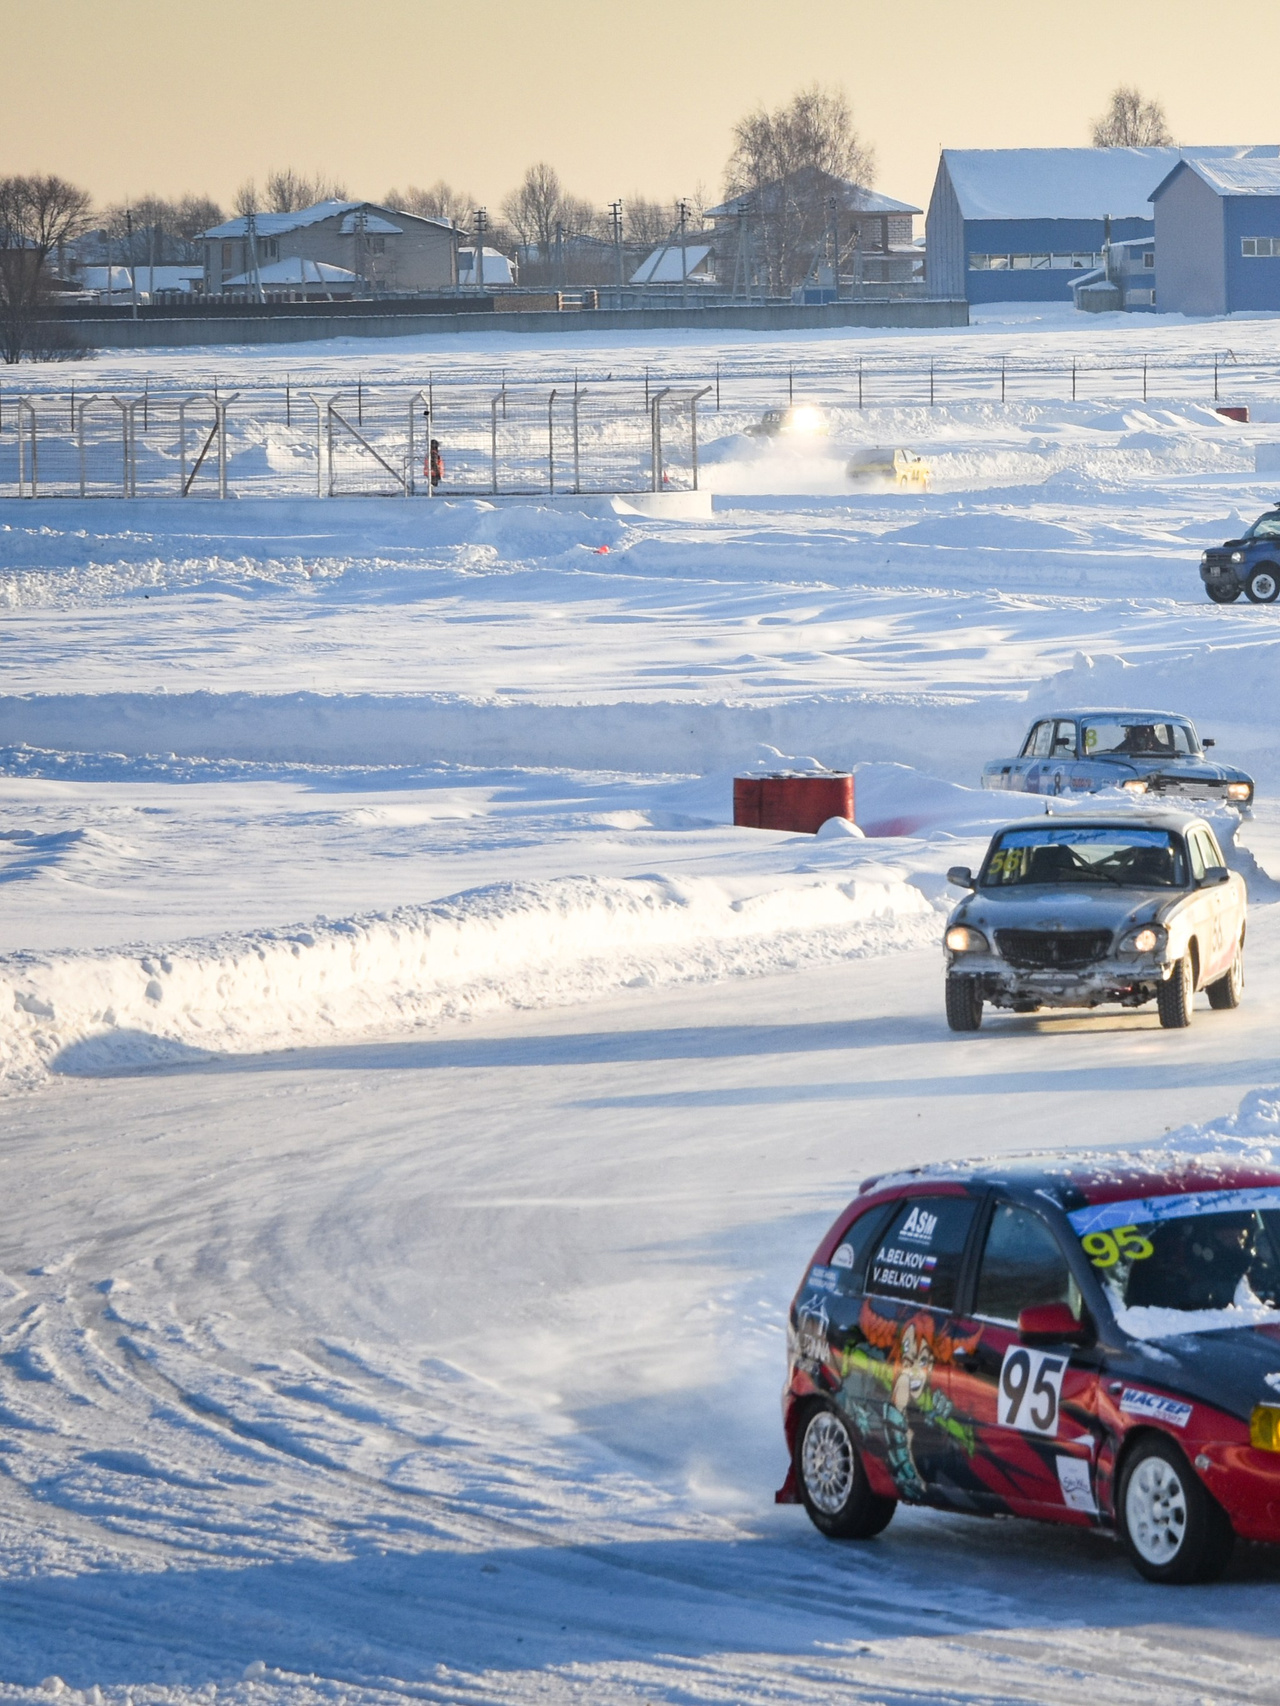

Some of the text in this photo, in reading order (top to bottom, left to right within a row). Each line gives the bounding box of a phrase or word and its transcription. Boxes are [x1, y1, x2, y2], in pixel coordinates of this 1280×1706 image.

[1085, 729, 1098, 747] 8
[989, 850, 1023, 874] 56
[903, 1207, 938, 1235] ASM
[876, 1246, 926, 1269] A.BELKOV
[1081, 1225, 1155, 1268] 95
[873, 1267, 920, 1290] V.BELKOV
[1002, 1349, 1065, 1431] 95
[1122, 1389, 1191, 1415] МАСТЕР
